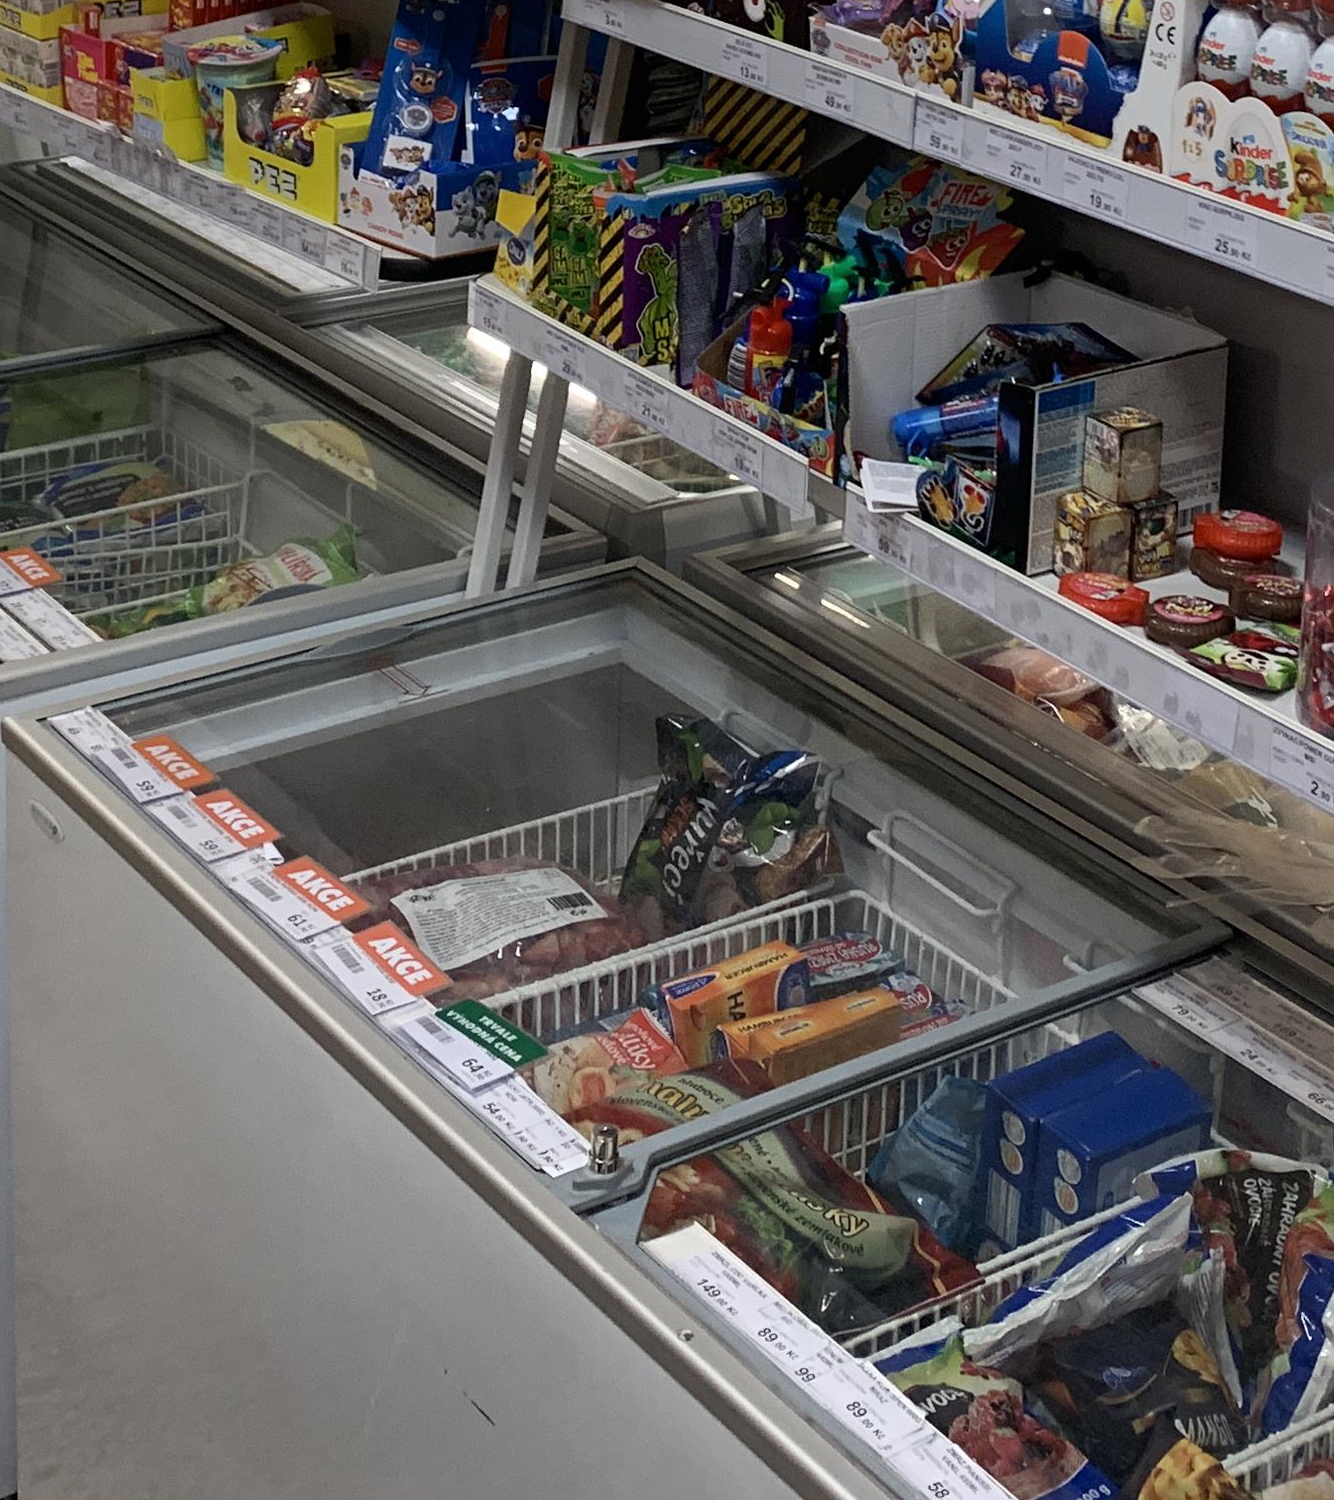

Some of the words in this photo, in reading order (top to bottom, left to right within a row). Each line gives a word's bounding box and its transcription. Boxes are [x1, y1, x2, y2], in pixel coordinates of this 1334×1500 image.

[248, 157, 299, 200] PEZ
[146, 744, 200, 781] AKCE
[206, 800, 265, 840] AKCE
[287, 869, 356, 912] AKCE
[367, 937, 434, 986] AKCE
[446, 1010, 495, 1044] VÝHODNÁ
[494, 1041, 523, 1062] CENA
[479, 1015, 518, 1042] TRVALE
